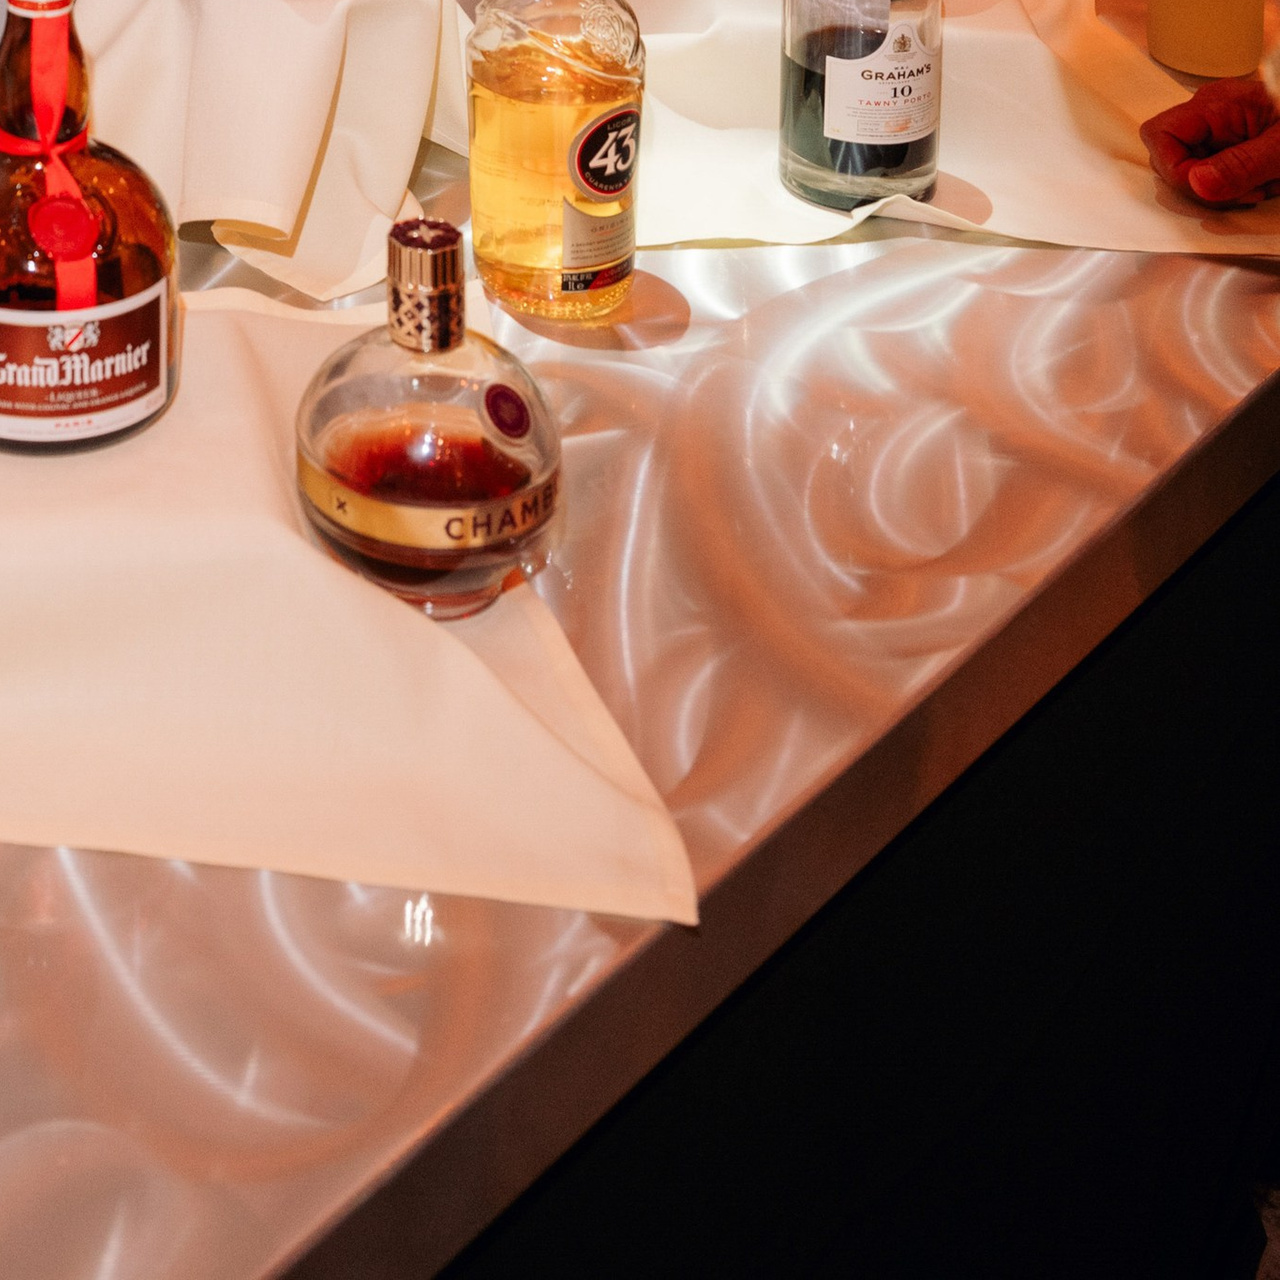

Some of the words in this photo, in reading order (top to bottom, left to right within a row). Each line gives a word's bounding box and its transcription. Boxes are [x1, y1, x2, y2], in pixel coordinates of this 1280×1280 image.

[861, 63, 931, 81] GRAHAM'S
[858, 99, 898, 107] TAWNY
[903, 92, 932, 105] PORTO
[891, 85, 913, 99] 10
[588, 122, 637, 177] 43
[58, 339, 152, 387] Marnier
[444, 486, 556, 541] CHAMB
